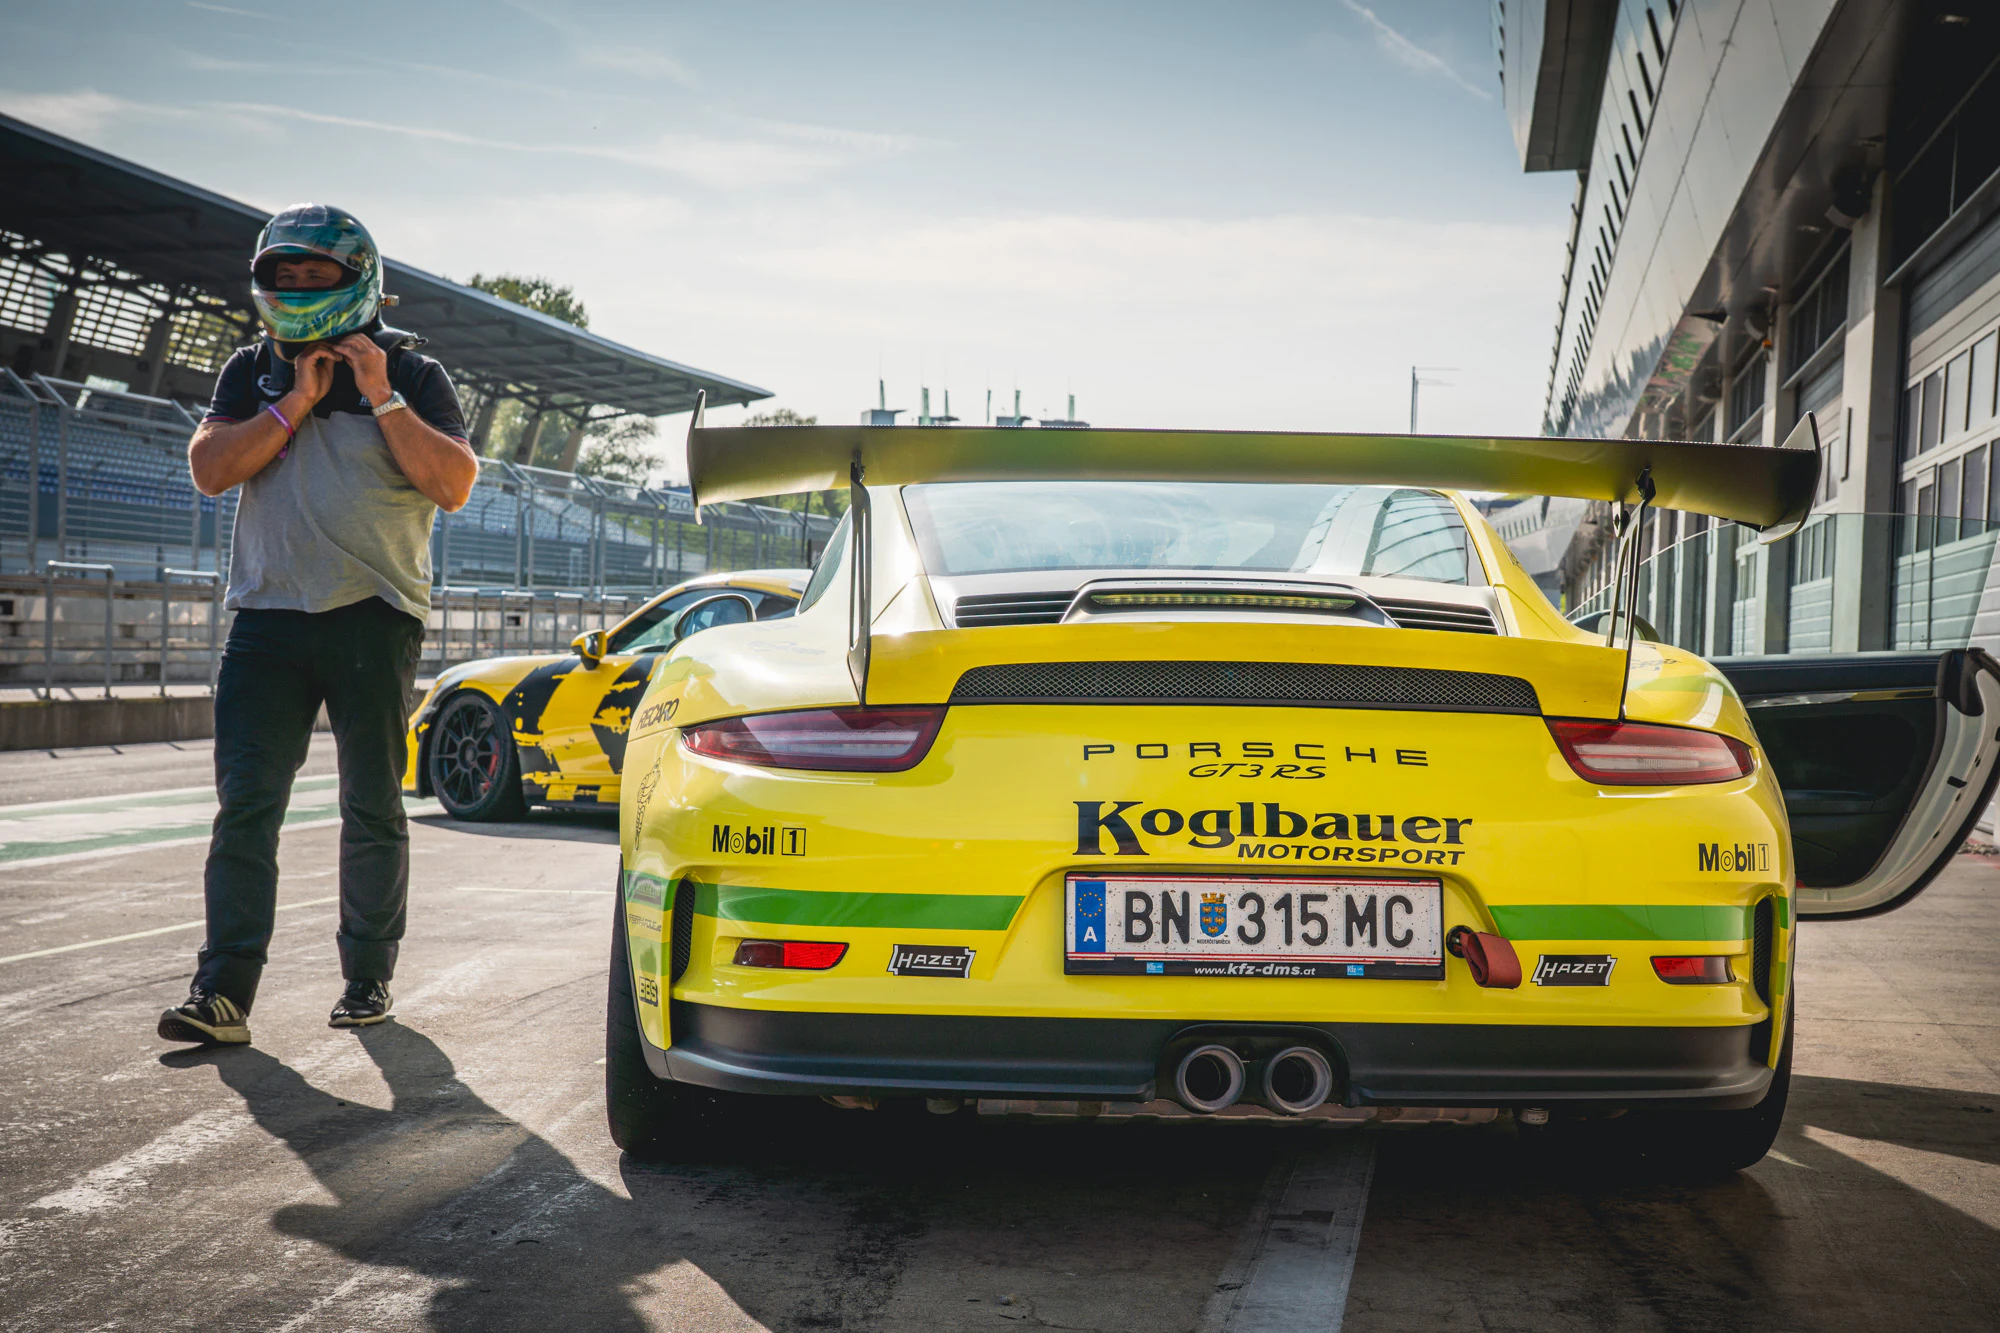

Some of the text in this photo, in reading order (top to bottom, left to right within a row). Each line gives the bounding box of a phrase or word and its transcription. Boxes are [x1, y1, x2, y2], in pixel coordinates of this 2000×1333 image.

[636, 698, 680, 731] RECARO
[1083, 742, 1429, 767] PORSCHE
[1188, 763, 1327, 780] GT3 RS
[712, 824, 775, 855] Mobil
[1072, 801, 1474, 856] Koglbauer
[1237, 843, 1466, 866] MOTORSPORT
[1698, 843, 1756, 872] Mobil
[1124, 890, 1414, 948] BN 315 MC
[1083, 926, 1098, 943] A
[896, 952, 967, 968] HAZET
[1194, 963, 1316, 976] www.kfz-dms.at
[1540, 962, 1608, 978] HAZET
